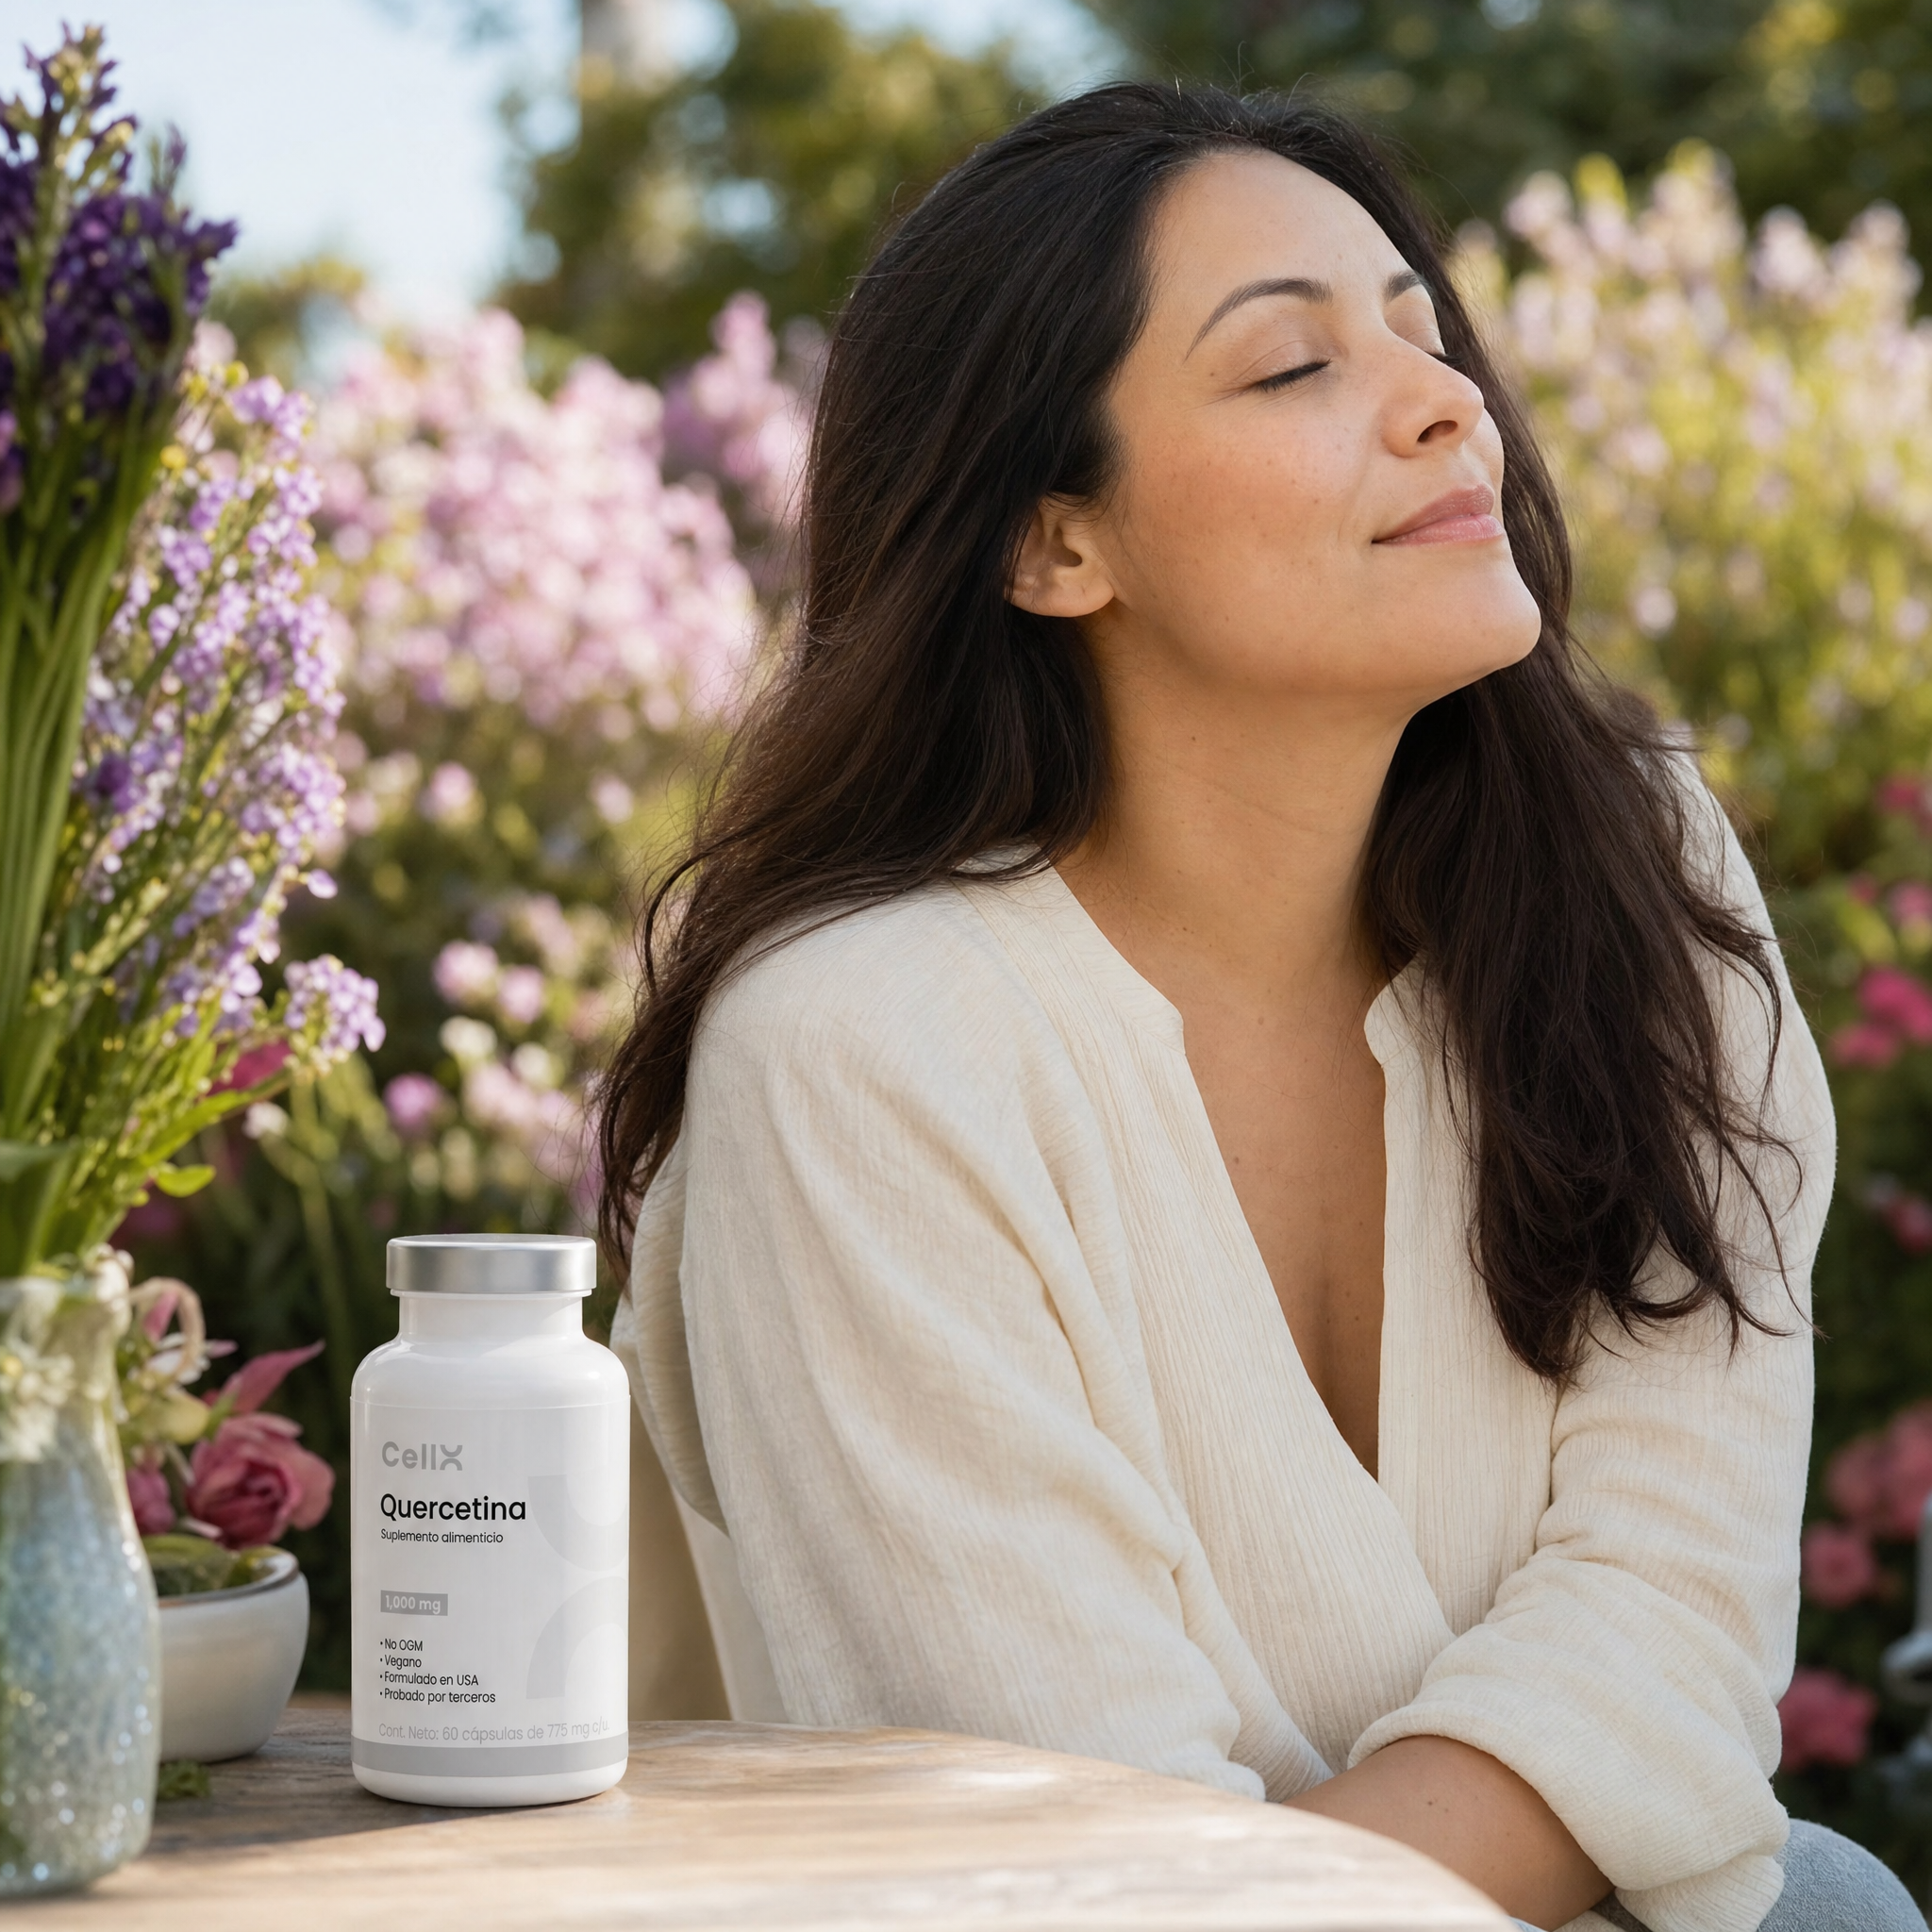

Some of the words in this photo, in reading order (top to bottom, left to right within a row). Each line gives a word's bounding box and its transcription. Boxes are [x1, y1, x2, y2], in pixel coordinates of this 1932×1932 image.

[380, 1493, 526, 1521] Quercetina
[380, 1528, 439, 1543] Suplemento
[441, 1530, 504, 1543] alimenticio
[385, 1594, 416, 1610] 1,000
[419, 1599, 441, 1615] mg
[384, 1638, 397, 1650] No
[399, 1640, 424, 1652] OGM
[384, 1654, 423, 1671] Vegano
[384, 1671, 437, 1686] Formulado
[440, 1676, 454, 1686] en
[457, 1674, 479, 1686] USA
[384, 1688, 425, 1702] Probado
[427, 1691, 446, 1706] por
[448, 1691, 496, 1703] terceros
[378, 1723, 406, 1739] Cont.
[408, 1725, 439, 1740] Neto:
[442, 1726, 458, 1740] 60
[461, 1725, 524, 1744] cápsulas
[526, 1724, 544, 1740] de
[547, 1723, 568, 1738] 775
[571, 1723, 590, 1740] mg
[591, 1715, 610, 1735] c/u.
